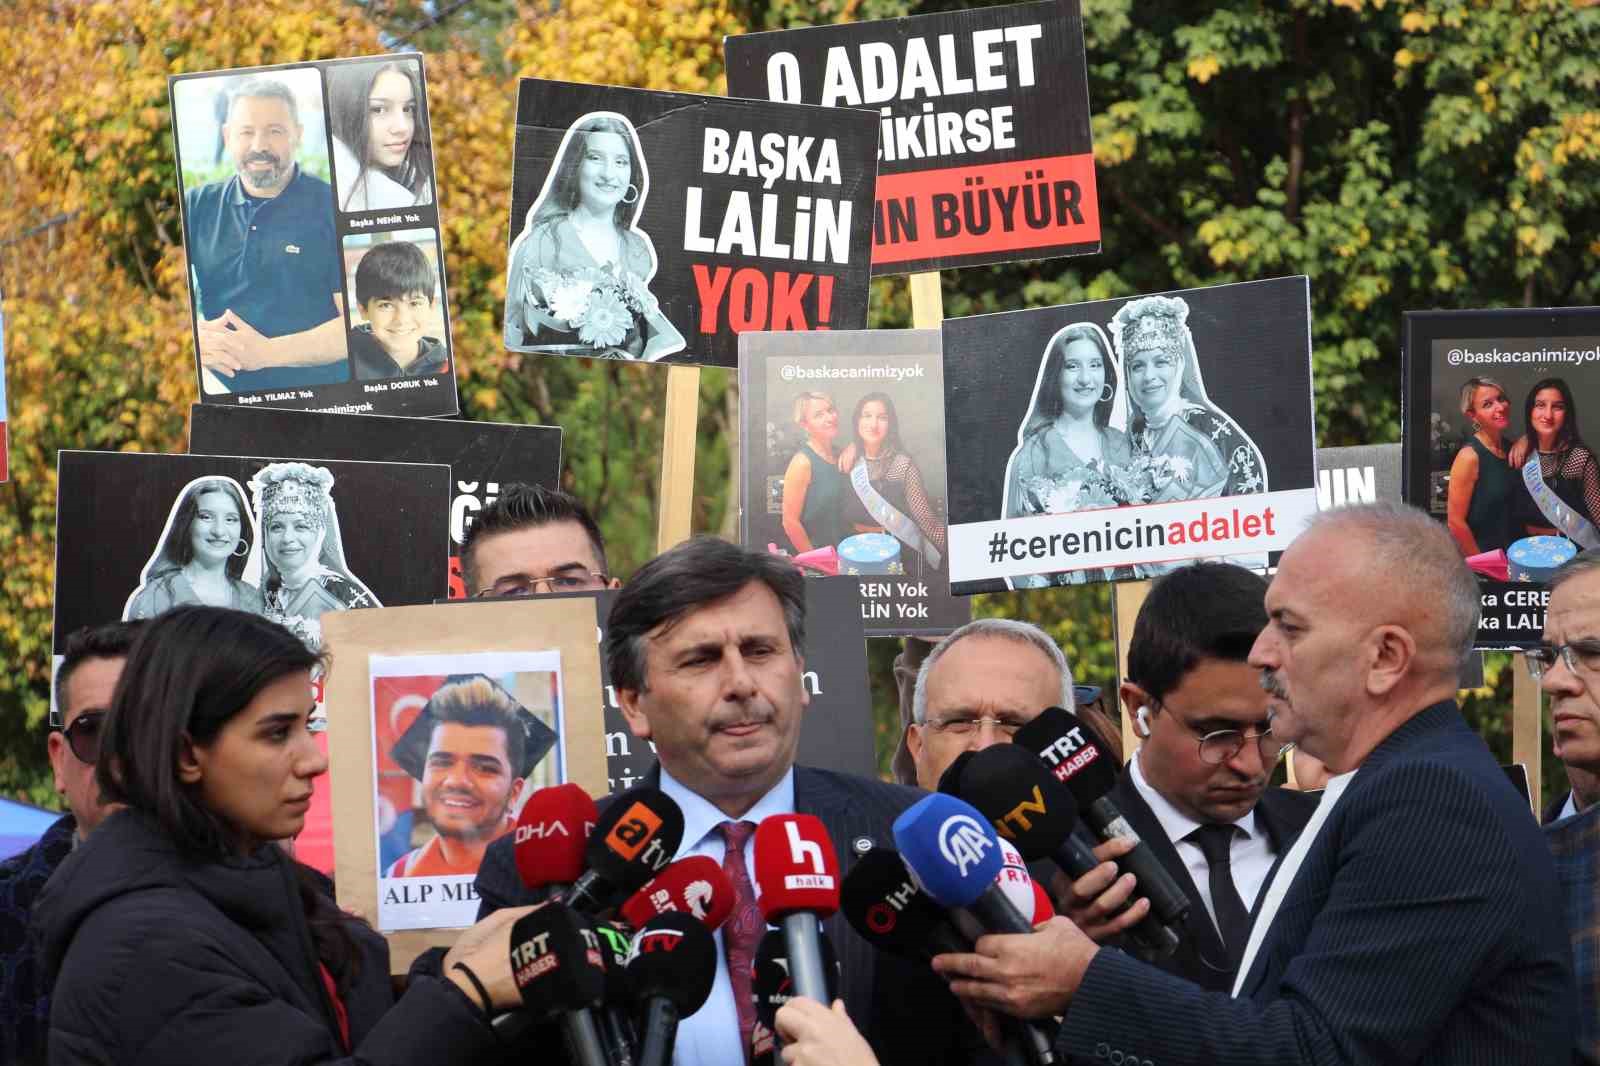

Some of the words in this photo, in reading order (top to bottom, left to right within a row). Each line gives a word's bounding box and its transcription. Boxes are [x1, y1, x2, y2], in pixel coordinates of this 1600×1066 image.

[821, 24, 1042, 107] ADALET
[877, 102, 1016, 161] İKİRSE
[702, 127, 842, 189] BAŞKA
[874, 196, 918, 246] IN
[931, 169, 1085, 239] BÜYÜR
[349, 218, 374, 228] Başka
[405, 213, 420, 223] Yok
[692, 264, 834, 336] YOK!
[781, 363, 925, 381] @baskacanimizyok
[364, 383, 388, 393] Başka
[390, 379, 421, 390] DORUK
[423, 377, 439, 387] Yok
[238, 394, 262, 405] Başka
[265, 391, 297, 402] YILMAZ
[299, 389, 314, 399] Yok
[988, 507, 1275, 563] #cerenicinadalet
[859, 583, 892, 597] REN
[897, 582, 929, 597] Yok
[1503, 590, 1551, 607] CERE
[861, 600, 891, 618] LİN
[895, 602, 929, 618] Yok
[1506, 608, 1549, 630] LALİ
[1039, 726, 1086, 765] TRT
[1055, 746, 1099, 782] HABER
[514, 820, 569, 845] DHA
[795, 876, 825, 887] halk
[384, 884, 433, 905] ALP
[510, 931, 550, 969] TRT
